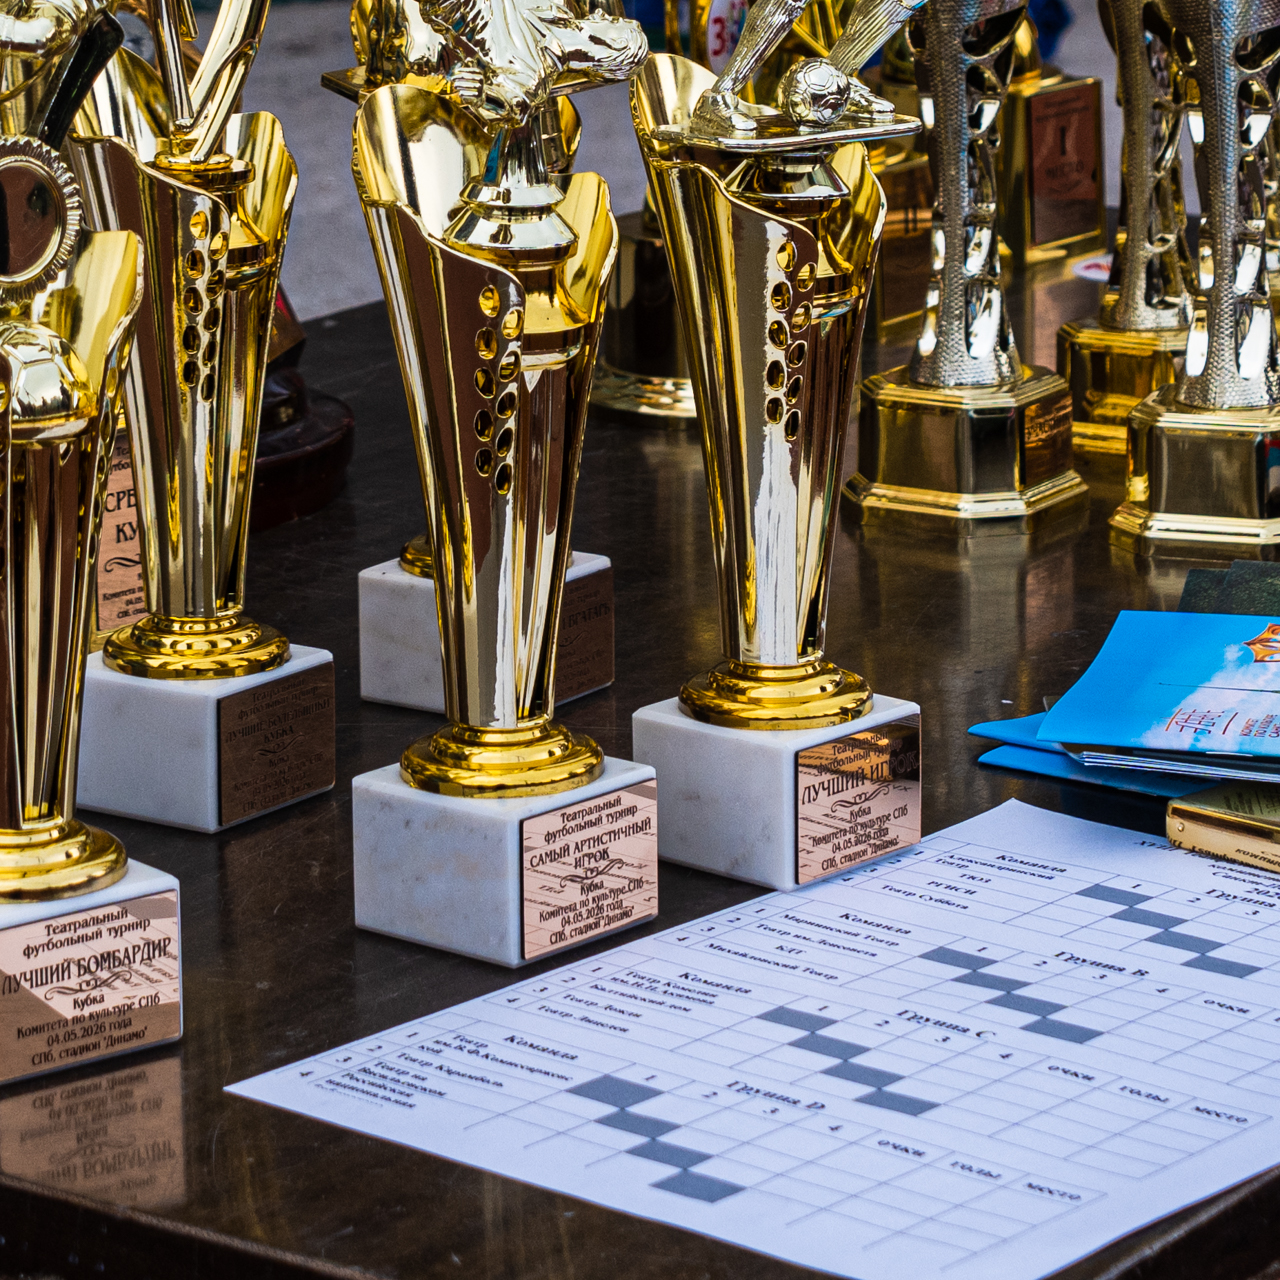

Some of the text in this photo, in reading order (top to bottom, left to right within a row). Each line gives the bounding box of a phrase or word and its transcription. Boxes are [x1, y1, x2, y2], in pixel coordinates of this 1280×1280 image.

[802, 751, 919, 805] ЛУЧШИЙ ИГРОК
[560, 795, 622, 824] Театральный
[849, 806, 871, 822] Кубка
[544, 805, 637, 844] футбольный турнир
[812, 804, 908, 847] Комитета по культуре СПб
[530, 817, 651, 868] САМЫЙ АРТИСТИЧНЫЙ
[832, 827, 889, 854] 04.05.2026 года
[574, 848, 610, 869] ИГРОК
[822, 856, 838, 871] СПб,
[840, 846, 868, 865] стадион
[935, 858, 970, 869] Театр
[995, 853, 1068, 874] Команда
[580, 880, 604, 896] Кубка
[926, 880, 977, 896] РГИСИ
[960, 873, 992, 884] ТЮЗ
[539, 877, 644, 923] Комитета по культуре СПб
[881, 884, 969, 910] Театр Суббота
[1205, 888, 1278, 913] Группа
[45, 908, 128, 936] Театральный
[561, 899, 623, 927] 04.05.2026 года
[23, 918, 151, 959] футбольный турнир
[550, 929, 568, 945] СПб,
[570, 917, 600, 940] стадион
[756, 922, 792, 935] Театр
[862, 935, 900, 947] Театр
[2, 937, 171, 996] ЛУЧШИЙ БОМБАРДИР
[705, 942, 839, 981] Михайловский Театр
[839, 912, 912, 935] Команда
[1203, 998, 1251, 1013] очки
[1053, 951, 1127, 973] Группа
[625, 971, 663, 984] Театр
[73, 994, 105, 1010] Кубка
[537, 1004, 574, 1019] Театр
[563, 993, 598, 1008] Театр
[17, 992, 160, 1038] Комитета по культуре СПб
[896, 1009, 971, 1034] Группа
[47, 1019, 132, 1046] 04.05.2026 года
[453, 1034, 489, 1048] Театр
[32, 1027, 148, 1065] СПб, стадион "Динамо"
[678, 971, 1250, 1123] Команда очки голы место
[373, 1061, 411, 1076] Театр
[397, 1052, 433, 1068] Театр
[725, 1079, 802, 1105] Группа
[503, 1035, 1082, 1201] Команда очки голы место
